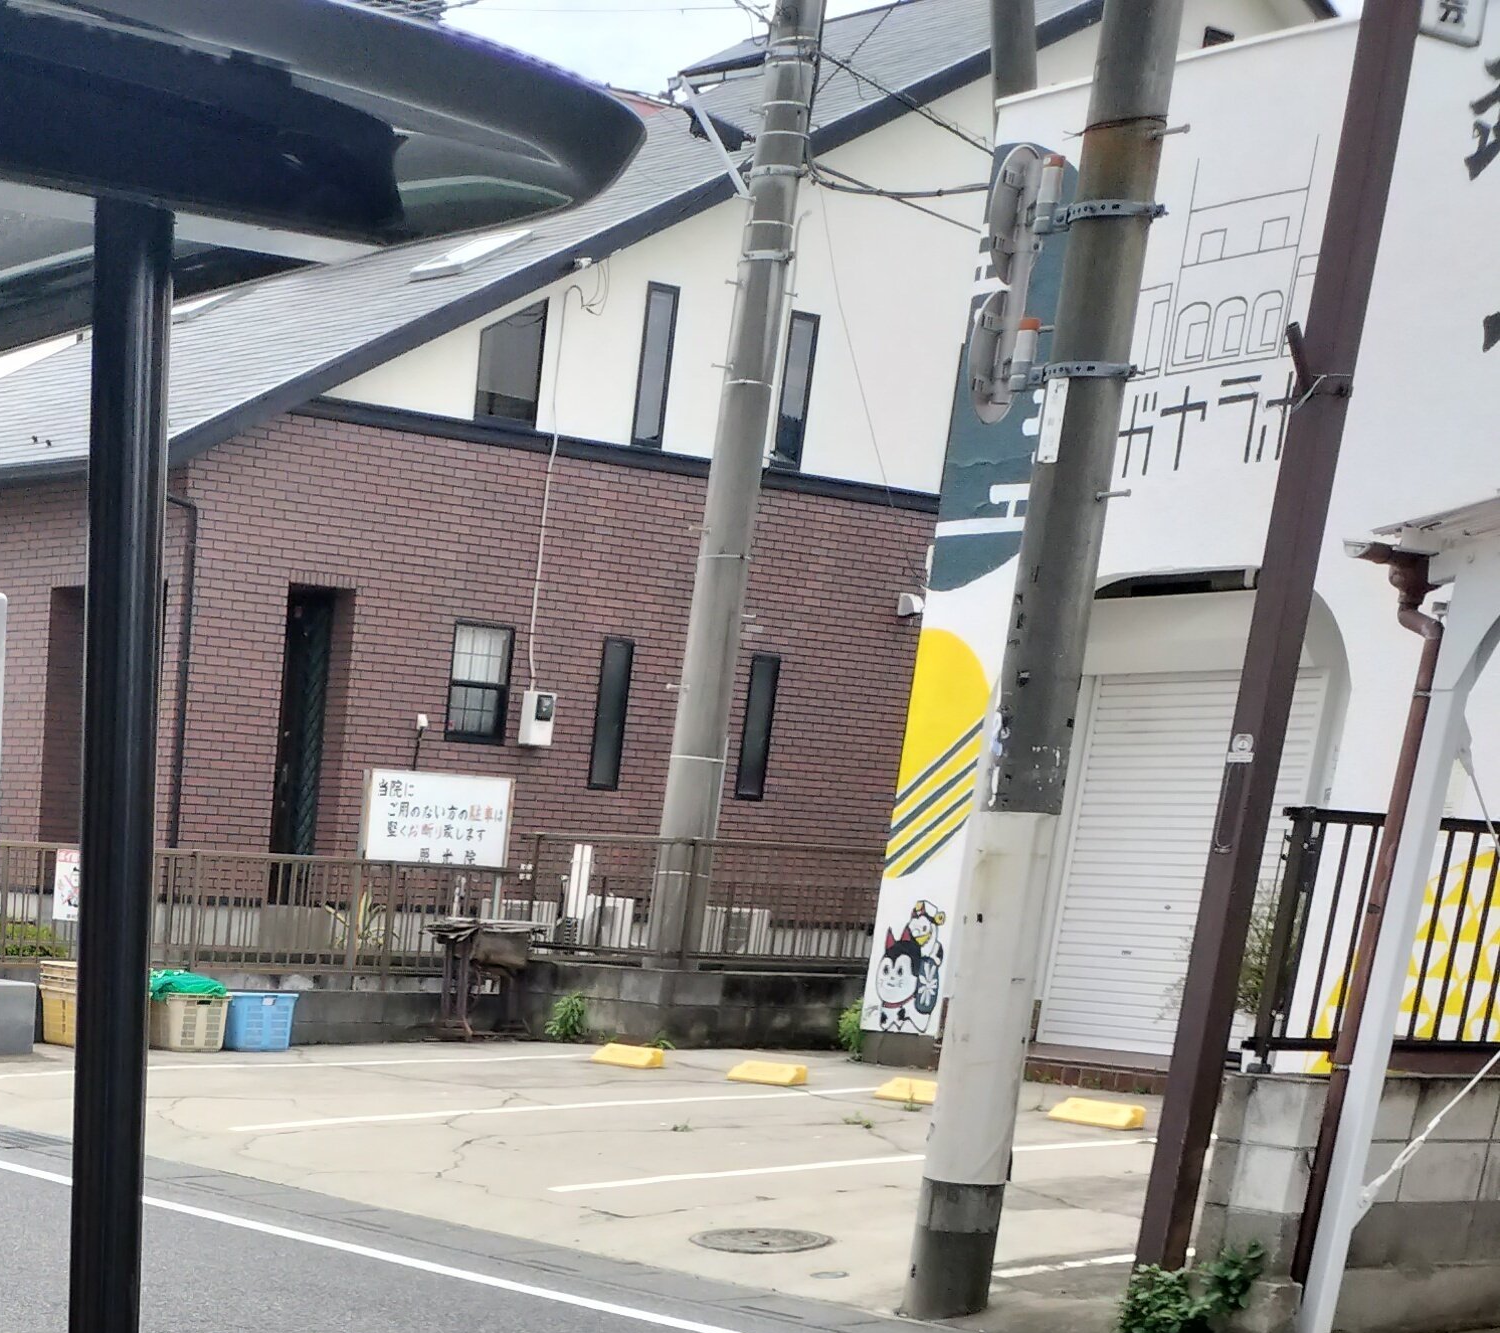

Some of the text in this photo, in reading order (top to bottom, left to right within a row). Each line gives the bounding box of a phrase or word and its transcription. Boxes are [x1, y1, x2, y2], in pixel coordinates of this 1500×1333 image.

[378, 779, 415, 798] 当院に
[388, 801, 503, 823] ご用のない方の駐車は
[386, 820, 487, 842] 堅くお断り致します
